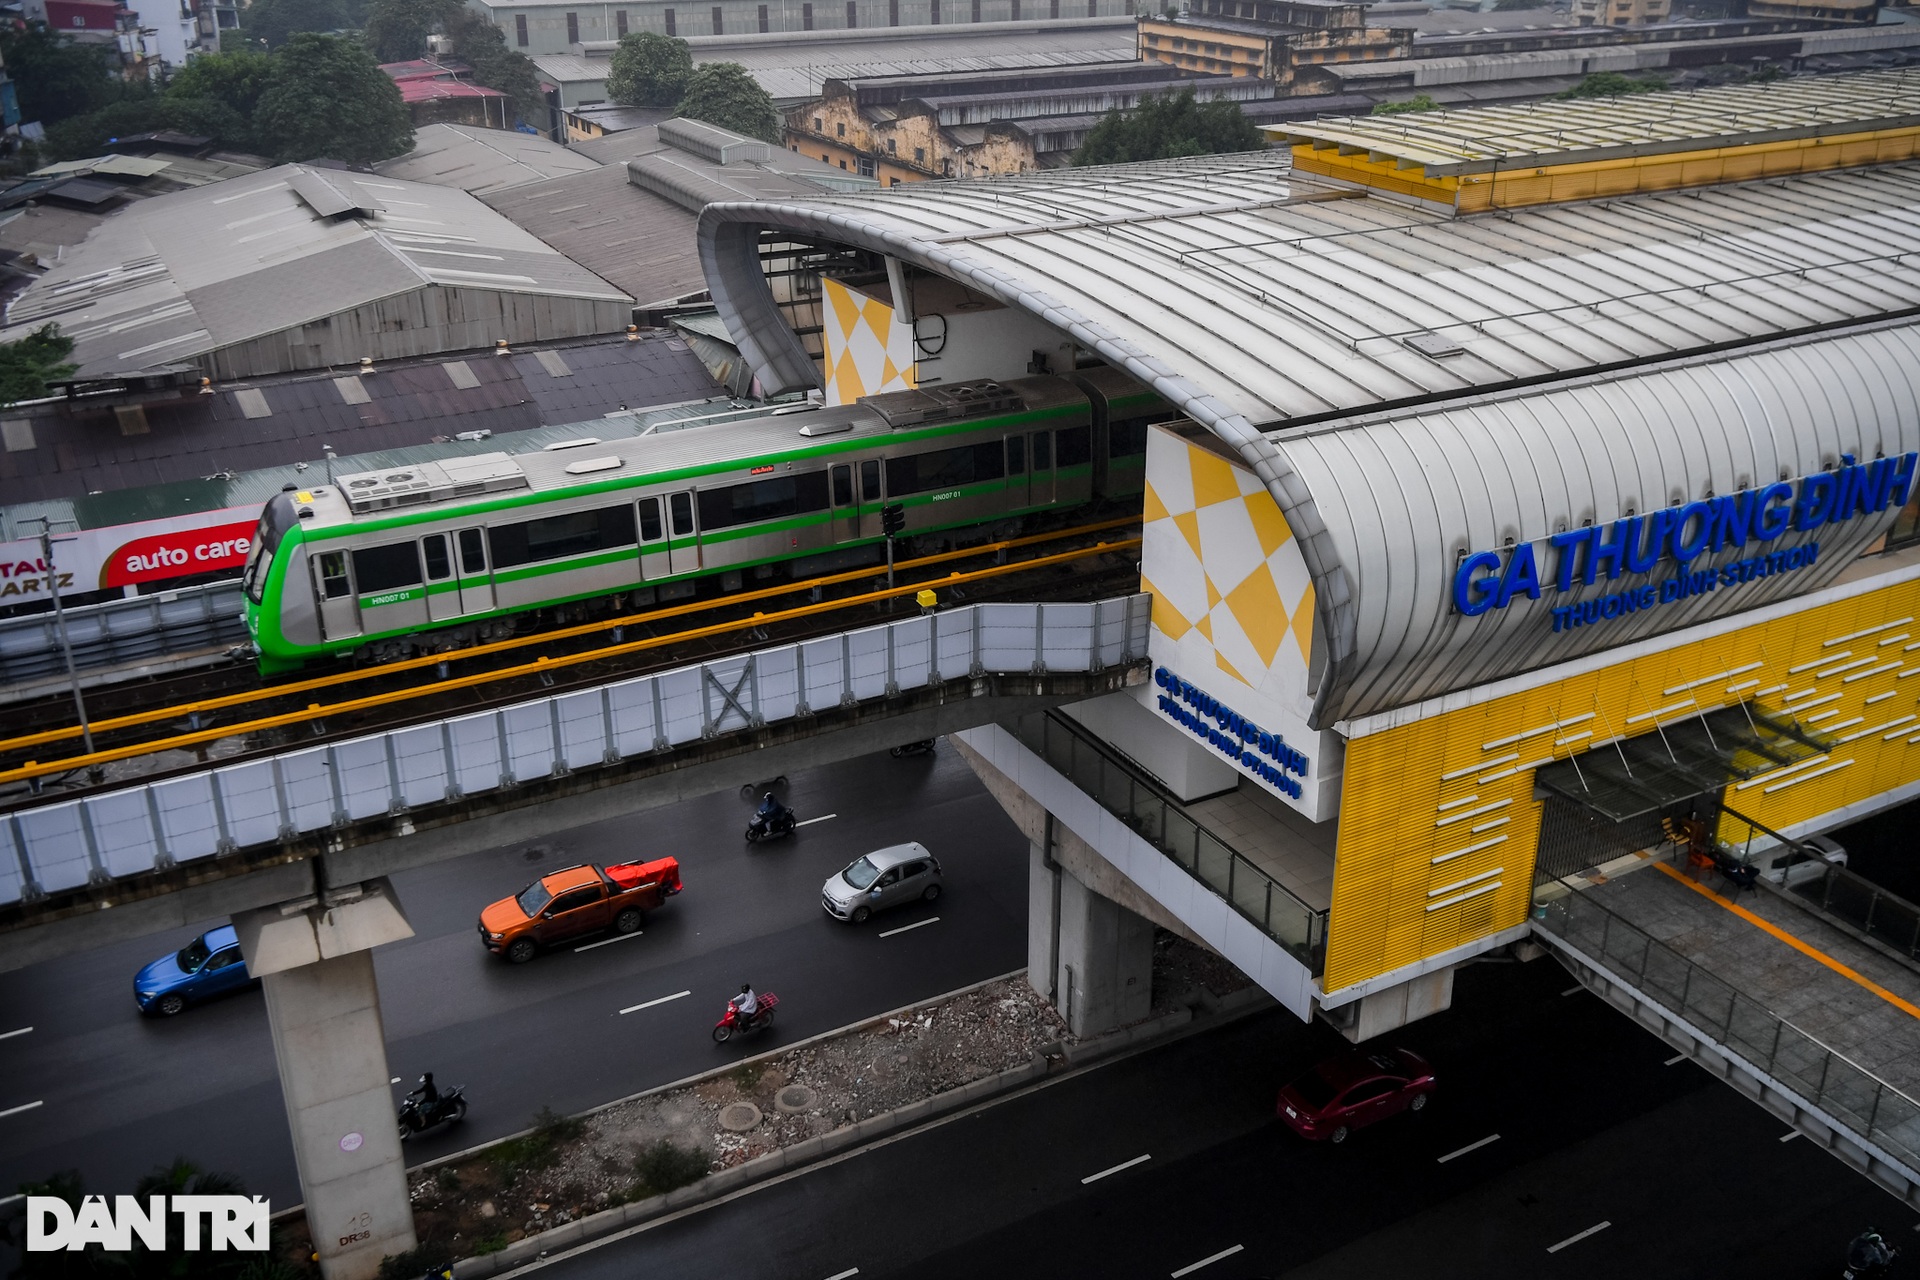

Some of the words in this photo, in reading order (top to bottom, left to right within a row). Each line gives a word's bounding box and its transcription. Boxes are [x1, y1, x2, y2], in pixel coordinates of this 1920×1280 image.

[932, 491, 953, 502] HN007
[1453, 551, 1541, 617] GA
[1795, 452, 1919, 532] ĐÌNH
[126, 547, 189, 572] auto
[194, 537, 250, 561] care
[372, 594, 398, 605] HN007
[400, 592, 410, 600] 01
[1551, 584, 1656, 633] THUONG
[1722, 542, 1819, 587] STATION
[1157, 694, 1209, 738] THUONG
[1241, 752, 1302, 800] STATION
[339, 1230, 371, 1247] DR38
